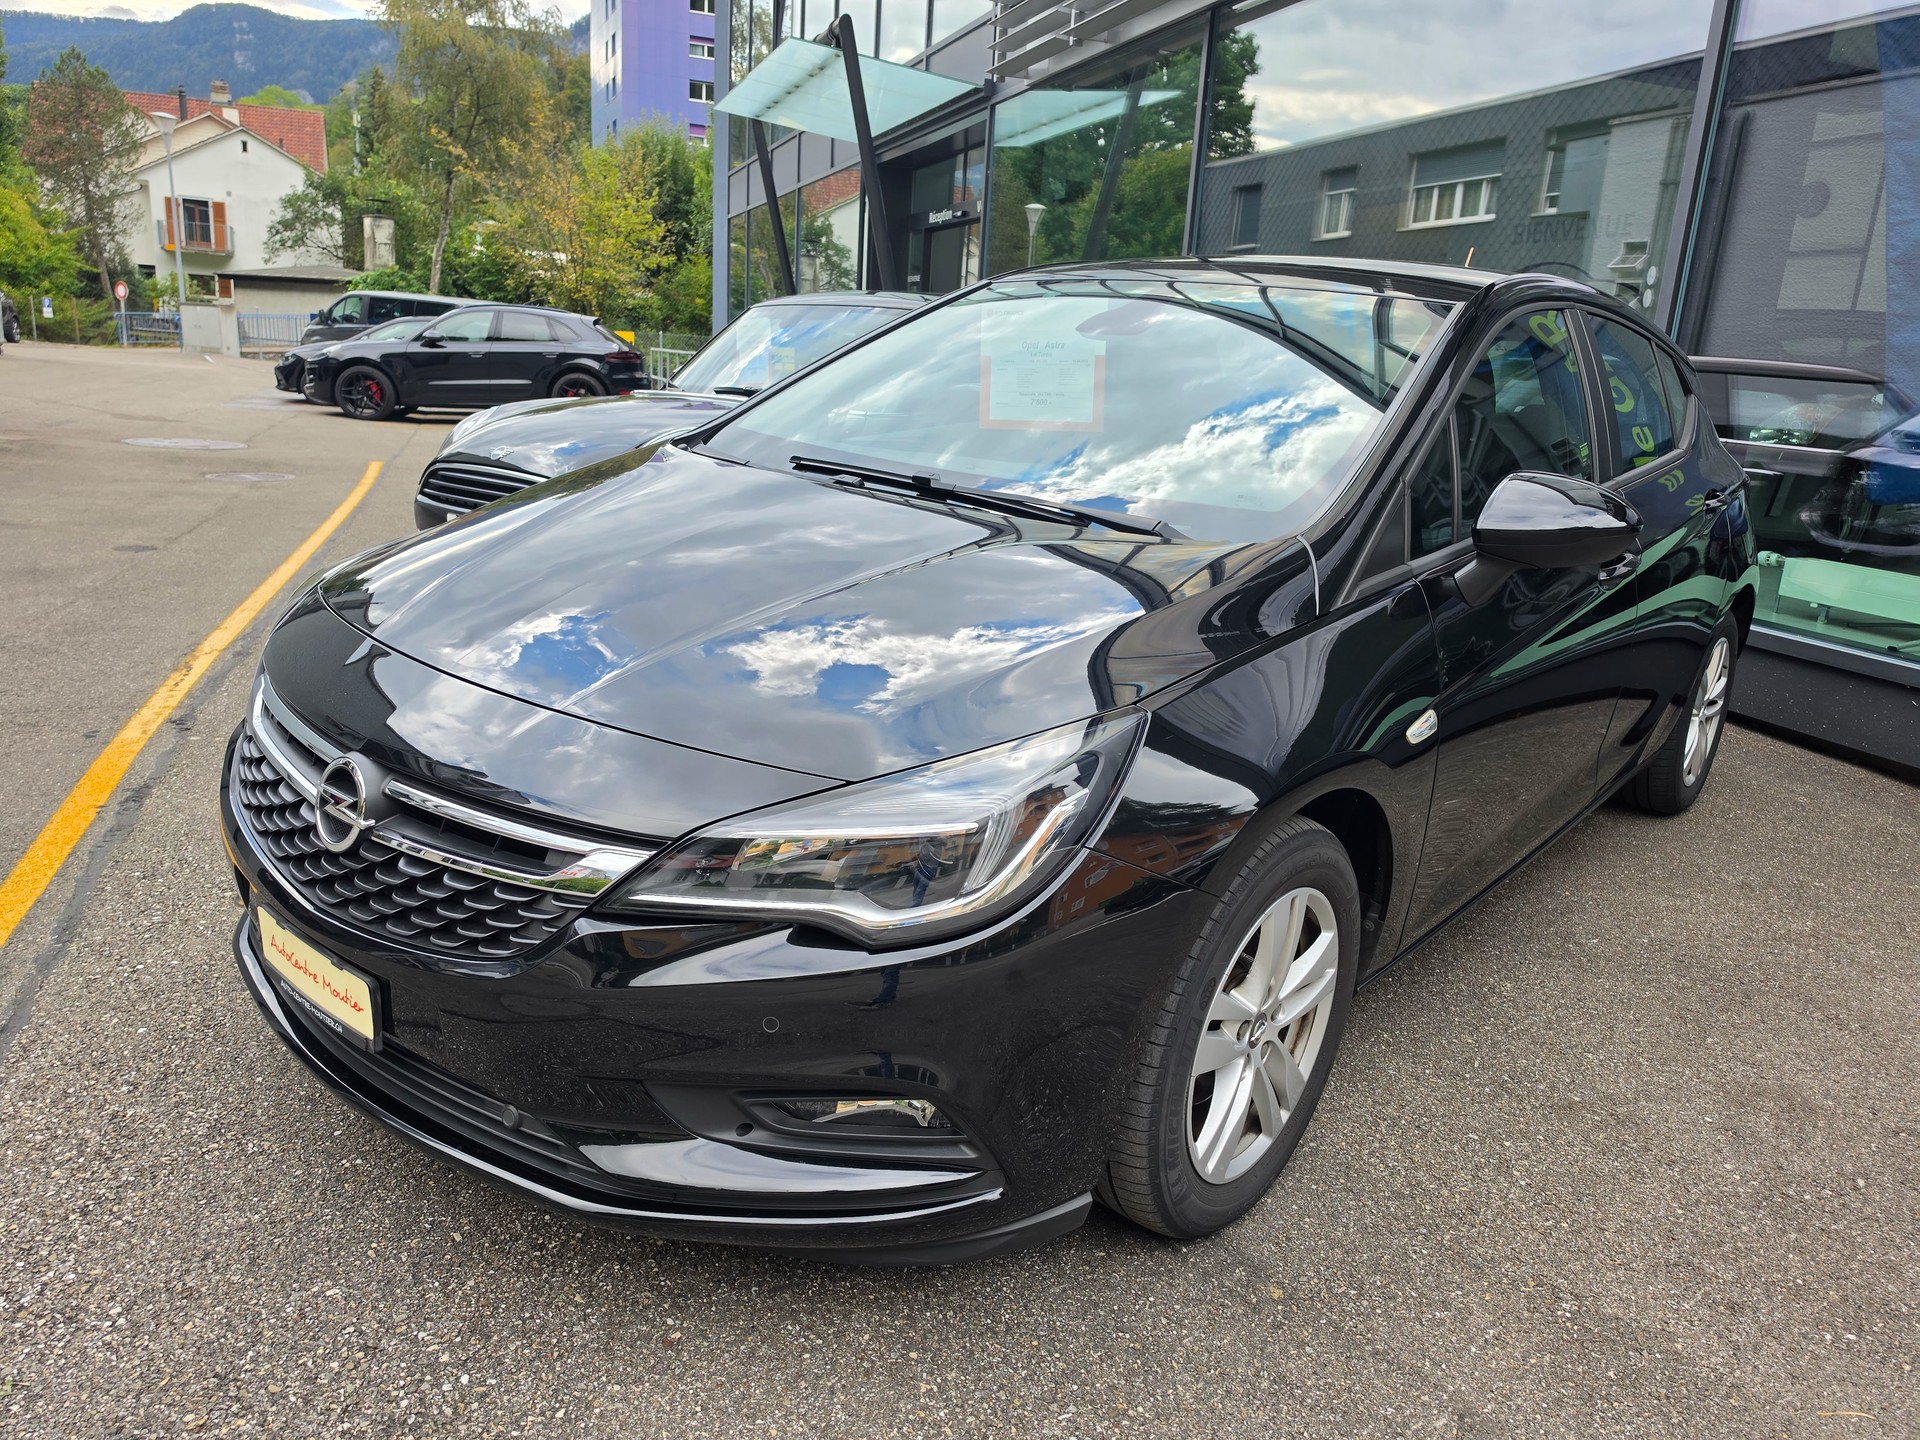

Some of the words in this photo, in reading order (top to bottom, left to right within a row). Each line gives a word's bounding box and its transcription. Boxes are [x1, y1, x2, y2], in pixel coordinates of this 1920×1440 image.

[929, 209, 952, 224] Réception
[1021, 340, 1040, 351] Opel
[1044, 340, 1066, 350] Astra
[322, 976, 364, 1012] Moutier
[1167, 1016, 1203, 1172] MICHIN
